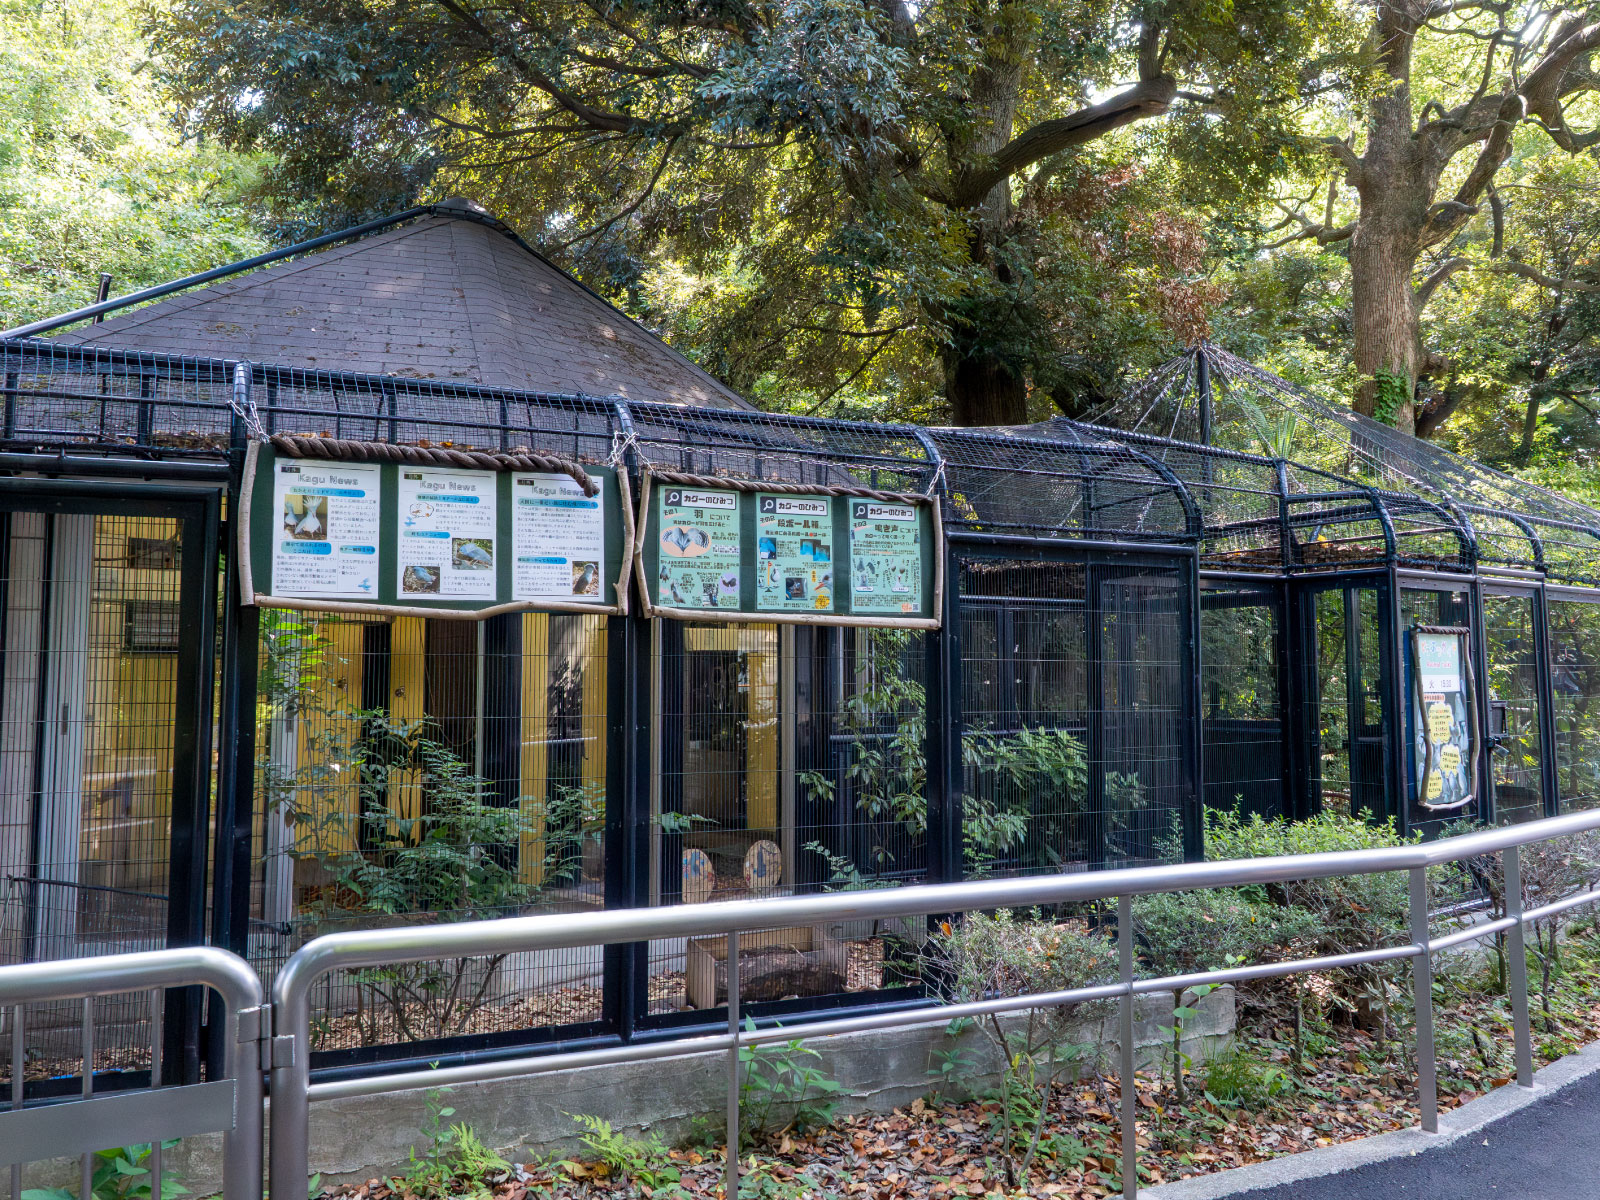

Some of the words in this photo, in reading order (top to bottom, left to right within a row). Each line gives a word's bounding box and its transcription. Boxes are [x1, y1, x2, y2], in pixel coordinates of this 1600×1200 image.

[297, 474, 326, 485] Kagu
[329, 475, 359, 486] News
[420, 481, 445, 491] Kagu
[449, 481, 477, 491] News
[532, 486, 557, 496] Kagu
[684, 494, 733, 505] カグーのひみつ
[779, 502, 825, 511] カグーのひみつ
[694, 509, 703, 518] 羽
[869, 507, 913, 517] カグーのひみつ
[875, 524, 899, 533] 鳴き声
